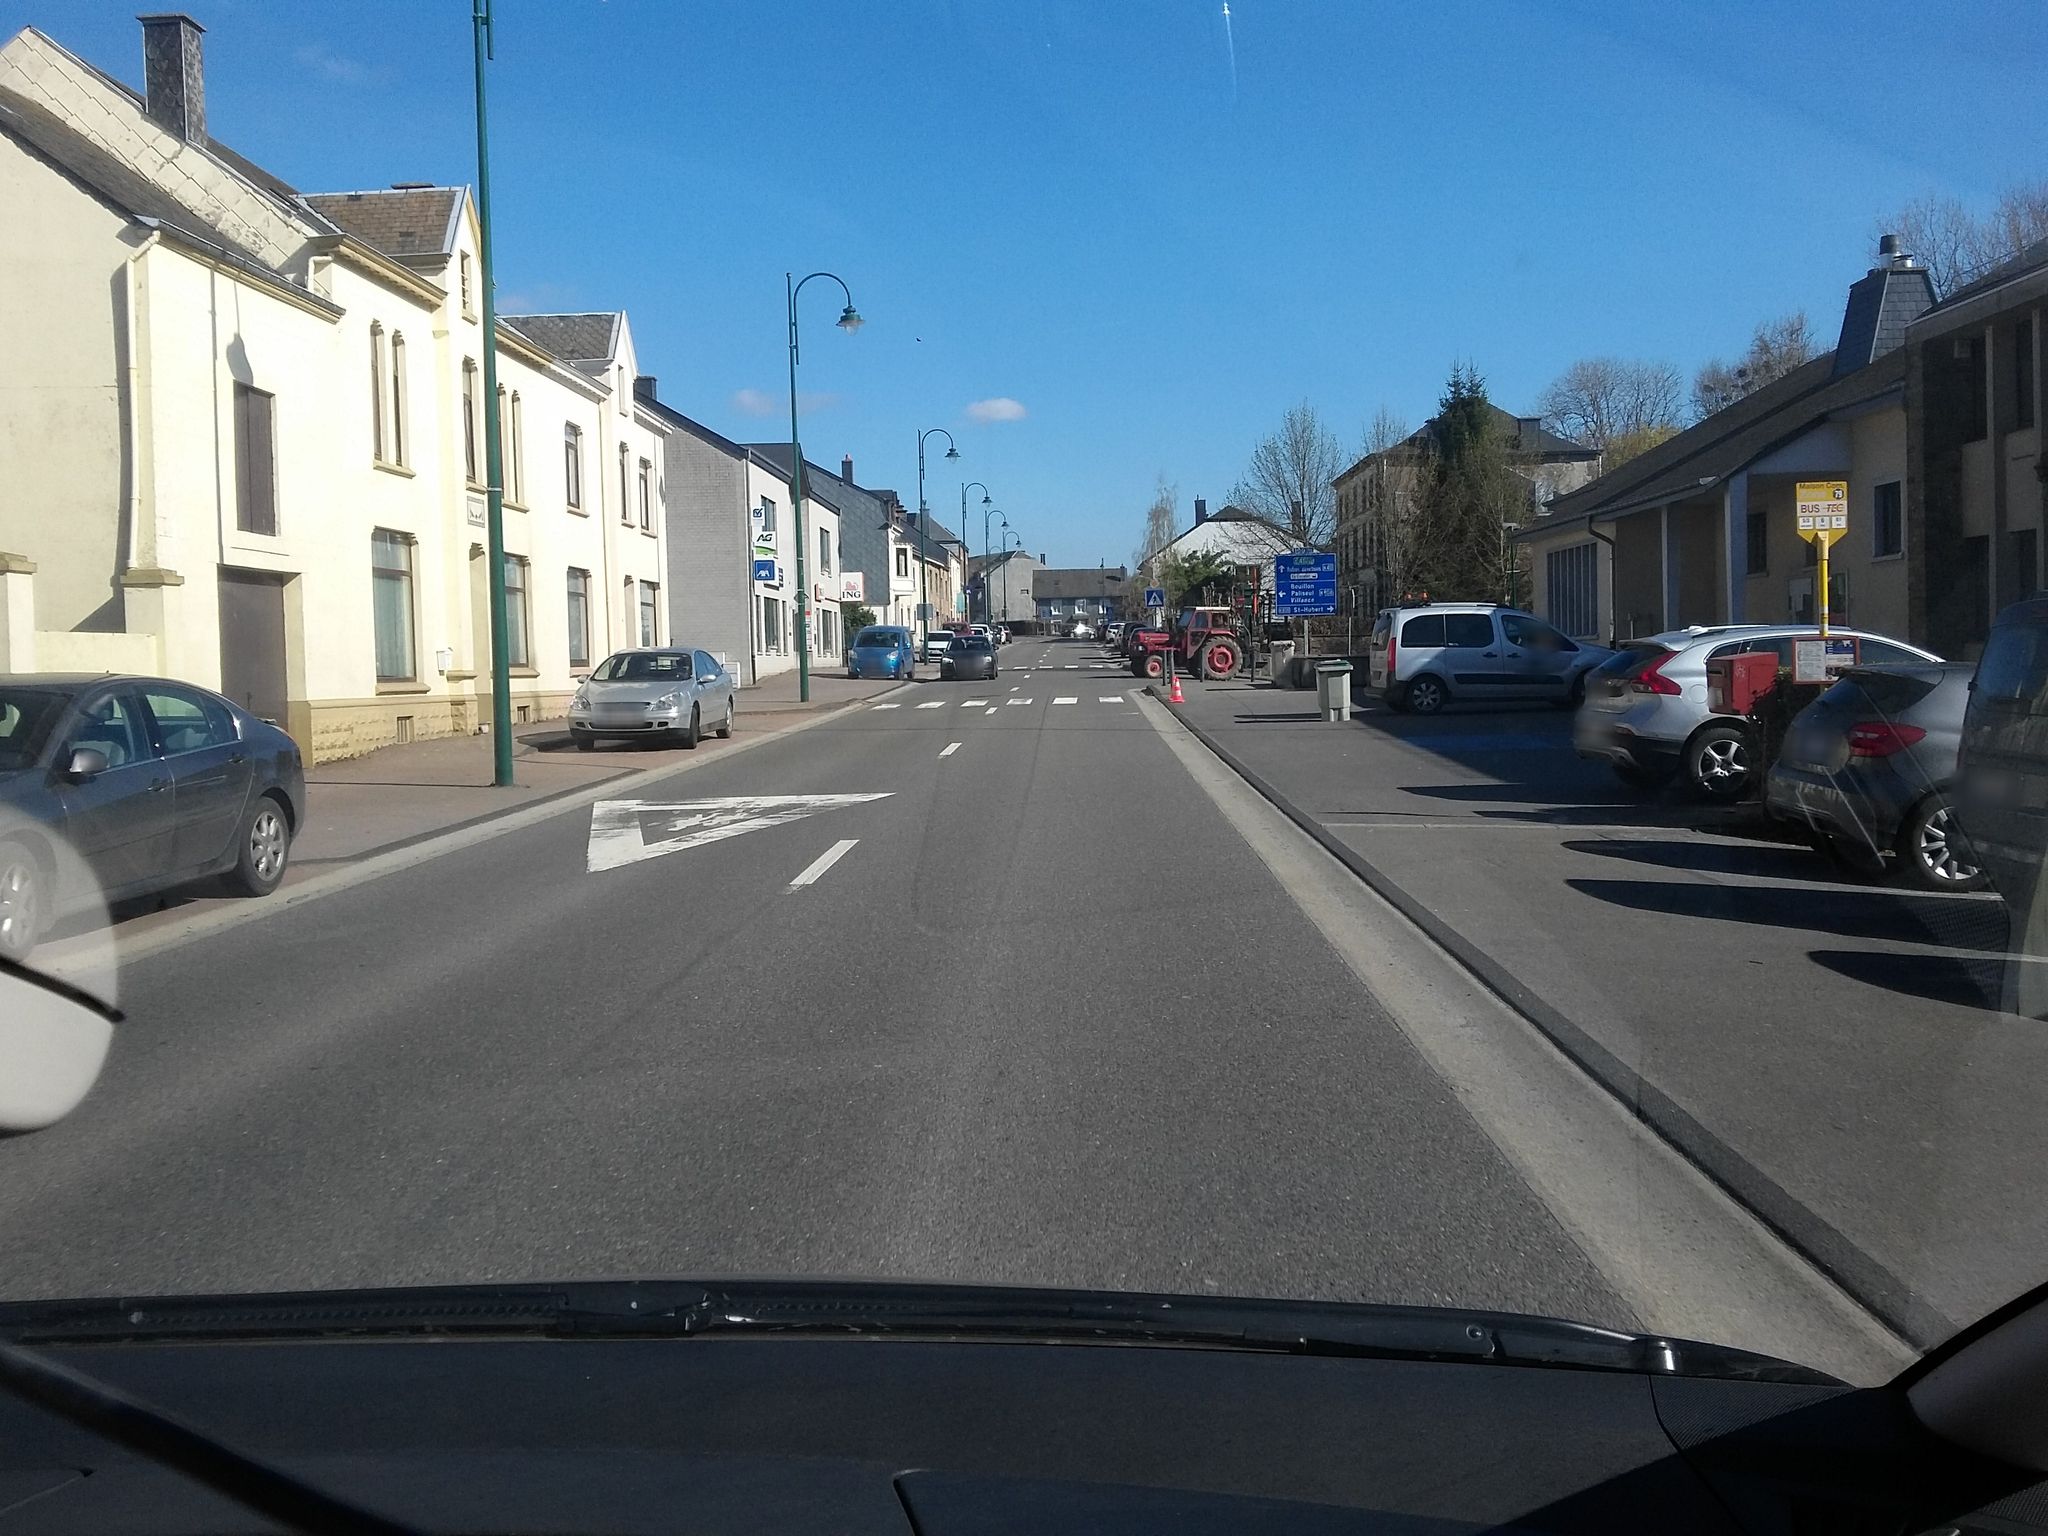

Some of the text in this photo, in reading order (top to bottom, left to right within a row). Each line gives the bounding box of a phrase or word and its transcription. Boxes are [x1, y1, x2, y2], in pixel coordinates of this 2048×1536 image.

[1800, 503, 1844, 513] BUS TEC
[756, 533, 773, 542] AG
[756, 569, 770, 578] AXA
[842, 591, 861, 599] ING
